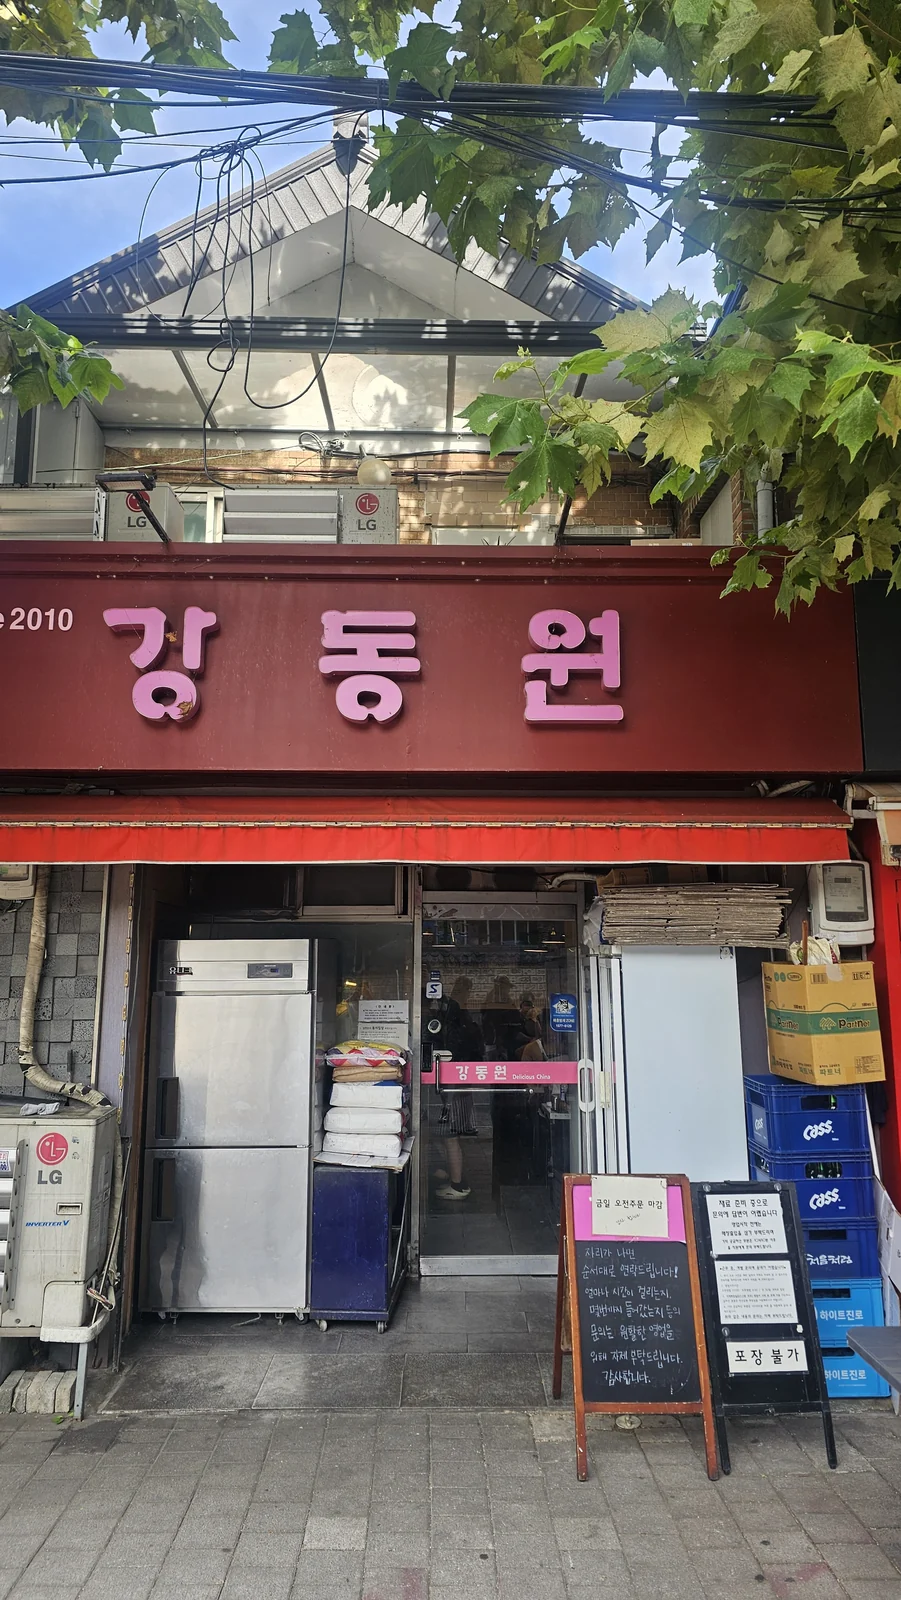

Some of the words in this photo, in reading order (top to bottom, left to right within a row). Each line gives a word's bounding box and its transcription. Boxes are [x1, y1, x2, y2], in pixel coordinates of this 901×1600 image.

[127, 516, 147, 528] LG
[357, 519, 377, 531] LG
[9, 607, 74, 631] 2010
[103, 606, 624, 725] 강동원
[455, 1065, 507, 1081] 강동원
[37, 1170, 63, 1185] LG
[596, 1198, 610, 1209] 금일
[614, 1199, 644, 1210] 오전주문
[647, 1200, 663, 1210] 마감
[718, 1199, 731, 1208] 재료
[735, 1199, 747, 1208] 준비
[750, 1198, 768, 1208] 중으로
[712, 1211, 729, 1219] 문의에
[731, 1210, 748, 1218] 답변이
[750, 1209, 778, 1217] 어렵습니다
[584, 1246, 613, 1258] 자리가
[616, 1247, 636, 1260] 나면
[806, 1253, 853, 1266] 처음처럼
[581, 1264, 616, 1279] 순서대로
[619, 1262, 679, 1279] 연락드립니다!
[584, 1286, 609, 1299] 얼마나
[612, 1286, 634, 1298] 시간이
[589, 1304, 622, 1317] 몇번까지
[625, 1300, 664, 1318] 들어갔는지
[665, 1304, 681, 1319] 등의
[819, 1310, 864, 1321] 하이트진로
[590, 1323, 614, 1342] 문의는
[619, 1324, 647, 1342] 원활한
[648, 1323, 675, 1341] 영업을
[590, 1351, 608, 1363] 위해
[610, 1349, 628, 1362] 자제
[630, 1349, 683, 1369] 부탁드립니다.
[734, 1349, 763, 1366] 포장
[770, 1348, 800, 1365] 불가
[601, 1369, 651, 1387] 감사합니다.
[824, 1369, 867, 1380] 하이트진로
